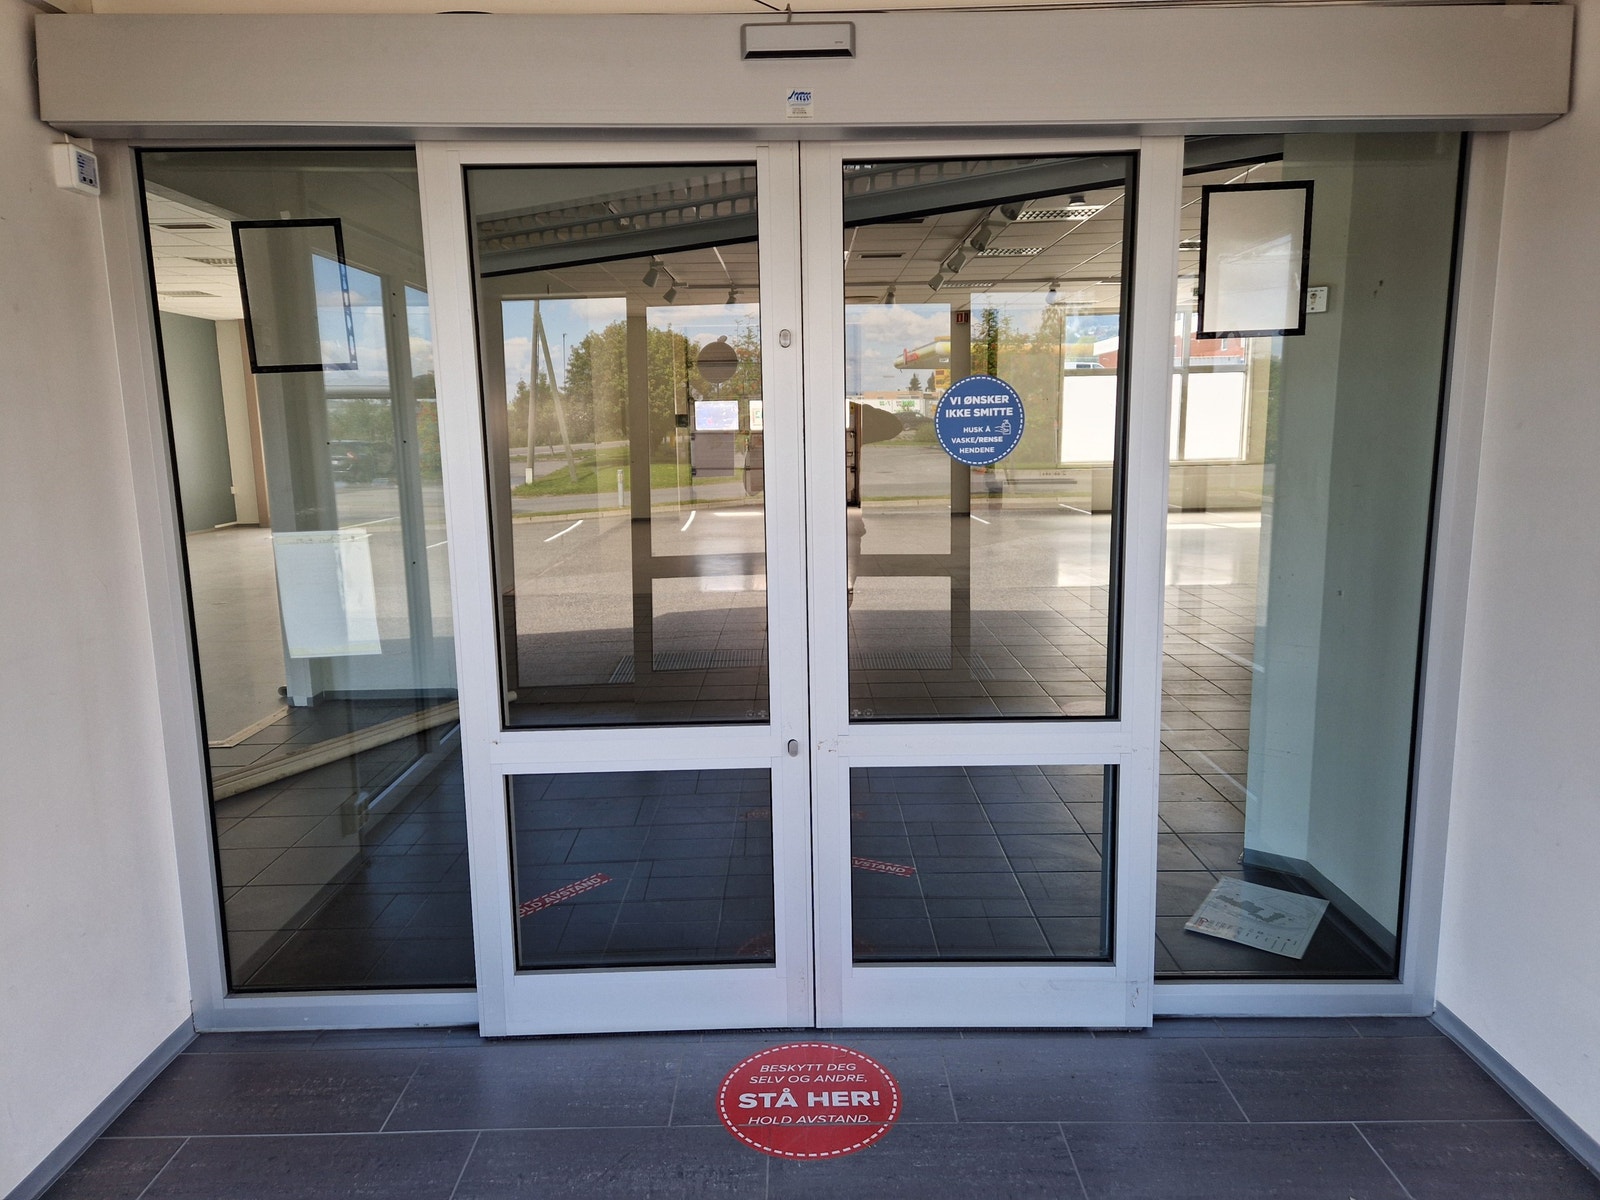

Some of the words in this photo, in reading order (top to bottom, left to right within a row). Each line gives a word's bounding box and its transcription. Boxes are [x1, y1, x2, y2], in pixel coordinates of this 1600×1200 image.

[950, 396, 961, 405] VI
[963, 395, 1009, 405] ØNSKER
[945, 408, 971, 417] IKKE
[973, 407, 1014, 417] SMITTE
[951, 436, 1003, 444] VASKE/RENSE
[959, 446, 995, 454] HENDENE
[852, 860, 906, 873] VSTAND
[544, 877, 601, 903] AVSTAND
[759, 1064, 824, 1073] BESKYTT
[826, 1063, 857, 1071] DEG
[749, 1075, 785, 1084] SELV
[788, 1075, 811, 1083] OG
[738, 1087, 799, 1109] STÅ
[807, 1091, 880, 1107] HER!
[748, 1116, 793, 1125] HOLD
